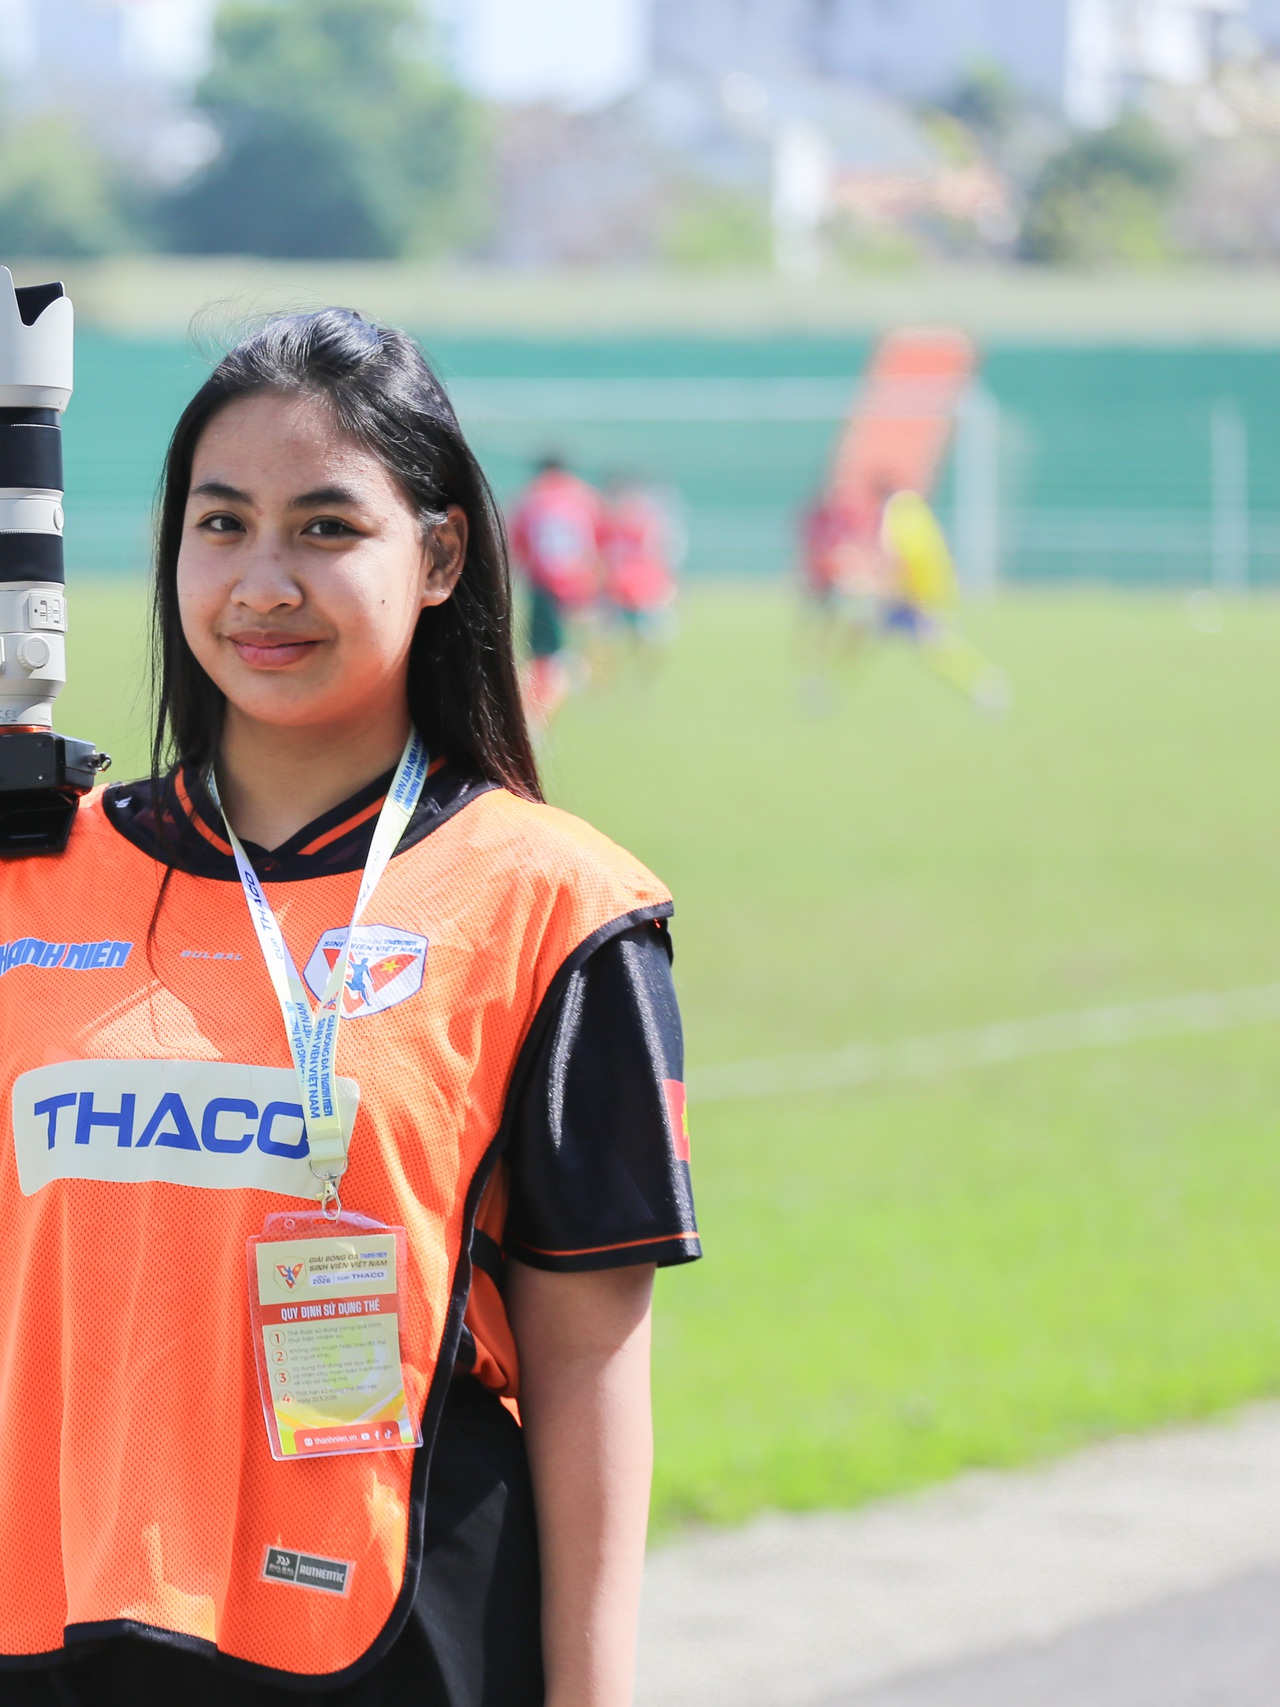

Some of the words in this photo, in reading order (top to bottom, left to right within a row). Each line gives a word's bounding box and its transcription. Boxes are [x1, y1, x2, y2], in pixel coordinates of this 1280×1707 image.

[401, 764, 414, 783] VIỆT
[393, 780, 407, 803] NAM
[244, 870, 272, 931] THACO
[60, 940, 134, 970] NIÊN
[180, 950, 243, 960] BULBAL
[270, 937, 284, 960] CUP
[296, 1002, 310, 1024] NAM
[314, 1018, 326, 1041] SINH
[309, 1041, 321, 1065] VIÊN
[321, 1032, 332, 1058] BÓNG
[320, 1058, 330, 1071] ĐÁ
[306, 1066, 318, 1088] VIỆT
[320, 1072, 330, 1098] THANH
[309, 1089, 320, 1119] NAM
[34, 1092, 310, 1159] THACO
[350, 1261, 368, 1269] VIỆT
[281, 1308, 299, 1321] QUY
[300, 1306, 322, 1319] ĐỊNH
[338, 1302, 362, 1317] DỤNG
[363, 1298, 380, 1312] THẺ
[275, 1333, 280, 1344] 1
[275, 1351, 284, 1362] 2
[278, 1372, 287, 1383] 3
[282, 1393, 291, 1403] 4
[314, 1433, 358, 1445] thanhnien.vn
[299, 1564, 345, 1583] AUTHENTIC
